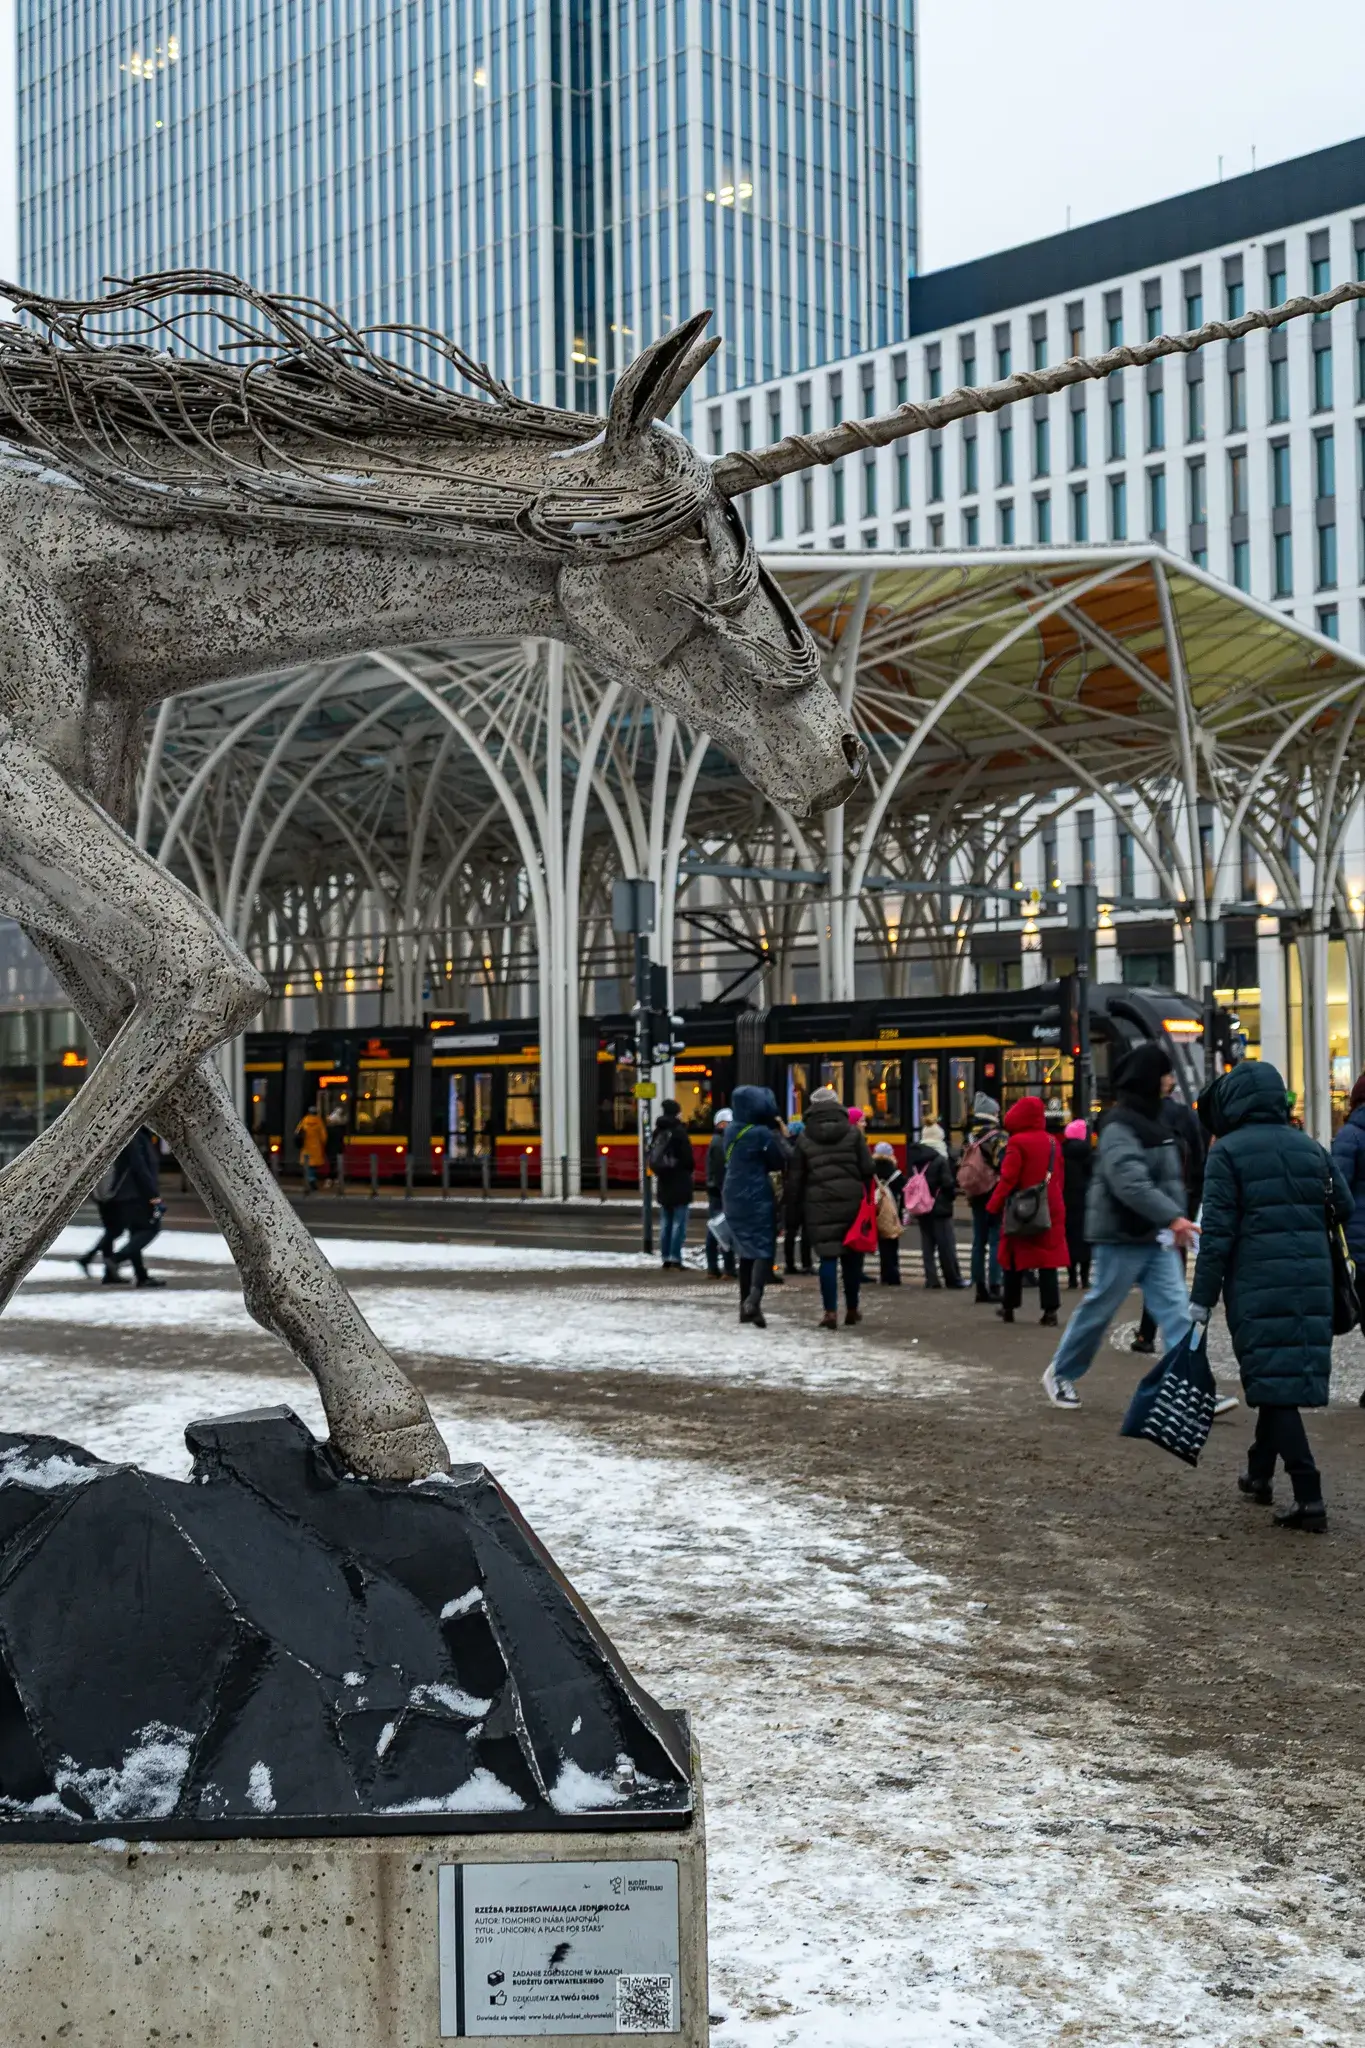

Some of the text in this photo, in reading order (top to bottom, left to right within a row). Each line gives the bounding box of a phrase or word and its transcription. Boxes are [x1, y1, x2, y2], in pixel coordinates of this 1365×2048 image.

[628, 1878, 648, 1886] BUDŻET
[475, 1902, 630, 1914] RZEŹBA PRZEDSTAWIAJĄCA JEDNOROŻCA
[475, 1917, 500, 1925] AUTOR:
[502, 1916, 541, 1924] TOMOHIRO
[544, 1925, 564, 1933] PLACE
[566, 1925, 580, 1933] FOR
[475, 1936, 493, 1944] 2019
[543, 1969, 583, 1977] ZGŁOSZONE
[594, 1968, 623, 1976] RAMACH
[512, 1977, 605, 1986] BUDŻETU OBYWATELSKIEGO
[512, 1995, 549, 2003] DZIĘKUJEMY
[560, 1993, 580, 2001] TWÓJ
